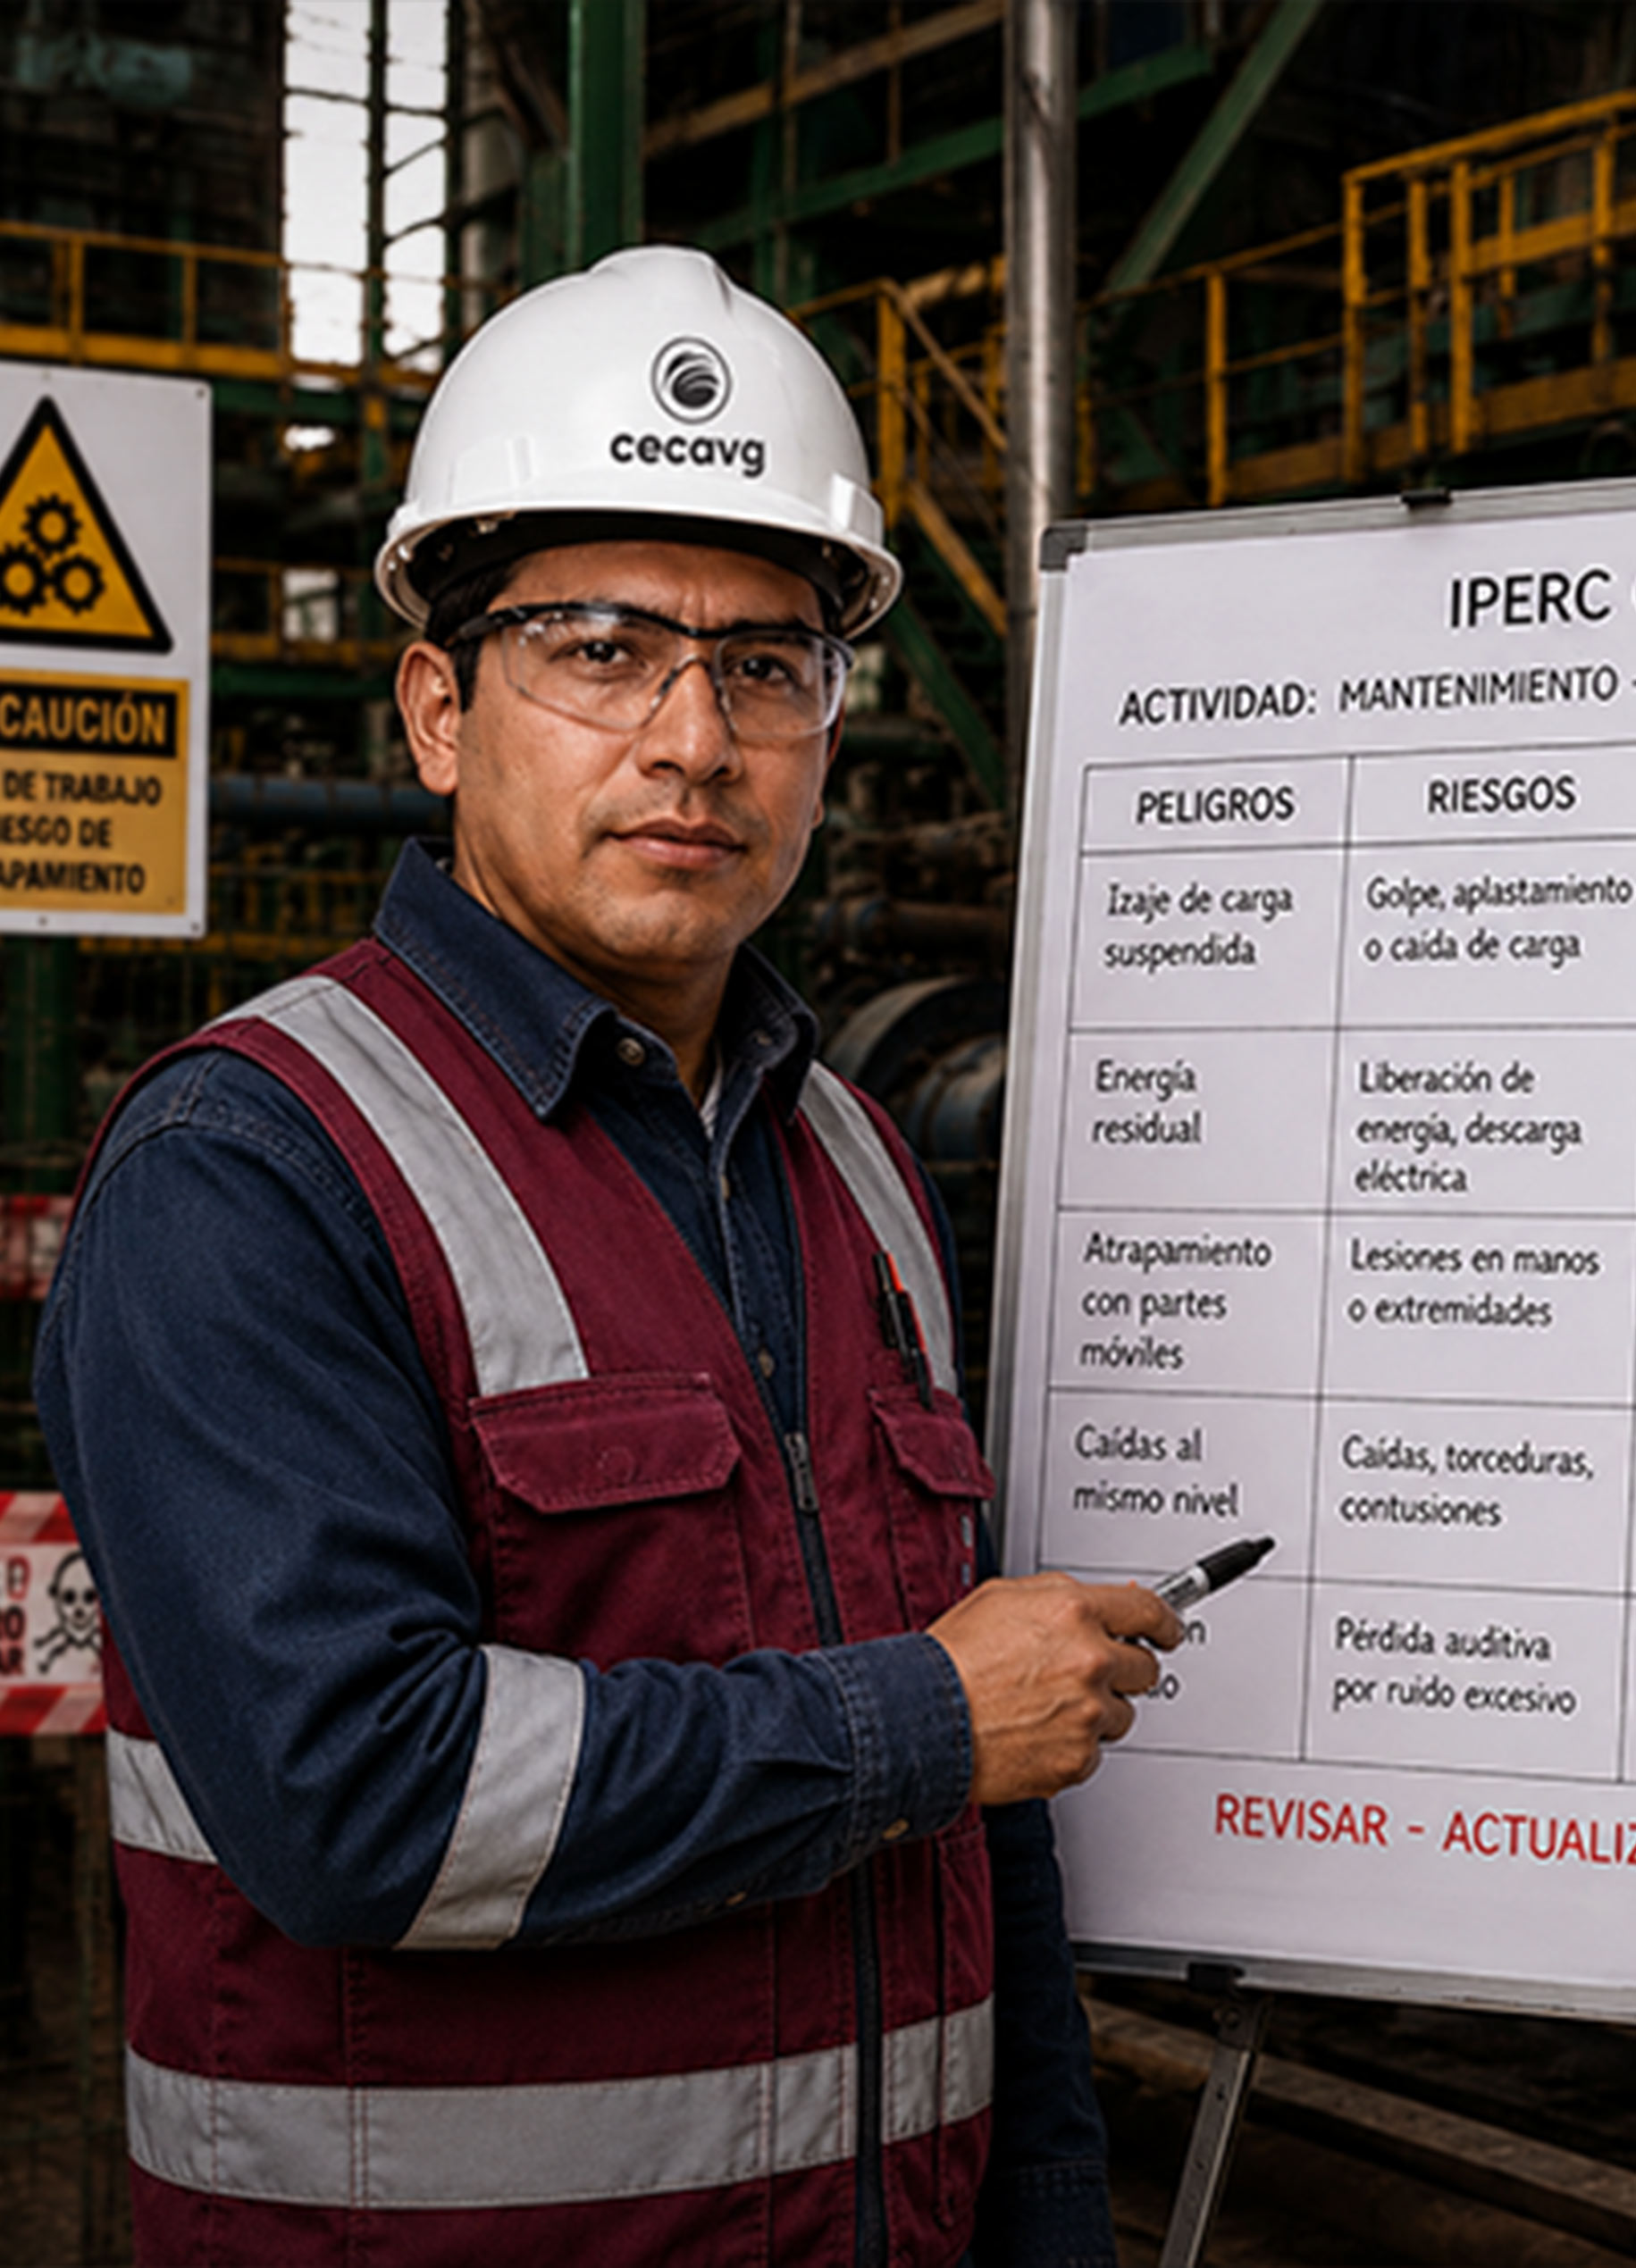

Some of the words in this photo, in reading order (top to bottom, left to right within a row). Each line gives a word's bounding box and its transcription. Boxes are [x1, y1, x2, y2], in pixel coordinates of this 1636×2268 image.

[608, 432, 767, 480] cecavg
[1450, 568, 1612, 629] IPERC
[1119, 682, 1317, 726] ACTIVIDAD:
[1338, 665, 1619, 713] MANTENIMIENTO
[4, 769, 37, 801] DE
[43, 770, 163, 807] TRABAJO
[1136, 785, 1296, 825] PELIGROS
[1427, 774, 1577, 815] RIESGOS
[78, 816, 112, 849] DE
[1107, 883, 1170, 925] Izaje
[1179, 882, 1212, 915] de
[1220, 888, 1294, 924] carga
[1366, 875, 1447, 918] Golpe,
[1452, 874, 1633, 916] aplastamiento
[1104, 933, 1256, 975] suspendida
[1363, 937, 1383, 962] o
[1465, 926, 1500, 960] de
[1507, 934, 1581, 970] carga
[1095, 1059, 1196, 1102] Energía
[1359, 1060, 1493, 1094] Liberación
[1500, 1060, 1535, 1094] de
[1091, 1110, 1202, 1144] residual
[1464, 1111, 1582, 1156] descarga
[1355, 1159, 1468, 1193] eléctrica
[1083, 1231, 1272, 1275] Atrapamiento
[1351, 1237, 1463, 1273] Lesiones
[1470, 1249, 1505, 1274] en
[1513, 1250, 1600, 1276] manos
[1081, 1291, 1131, 1317] con
[1139, 1288, 1228, 1326] partes
[1347, 1298, 1368, 1324] o
[1374, 1292, 1553, 1327] extremidades
[1079, 1335, 1184, 1370] móviles
[1075, 1423, 1167, 1461] Caídas
[1176, 1428, 1202, 1461] al
[1445, 1441, 1594, 1480] torceduras,
[1073, 1479, 1165, 1514] mismo
[1172, 1483, 1238, 1518] nivel
[1339, 1493, 1502, 1527] contusiones
[1335, 1616, 1436, 1656] Pérdida
[1444, 1625, 1551, 1661] auditiva
[1332, 1676, 1378, 1713] por
[1387, 1674, 1456, 1709] ruido
[1463, 1682, 1577, 1715] excesivo
[1215, 1793, 1388, 1846] REVISAR
